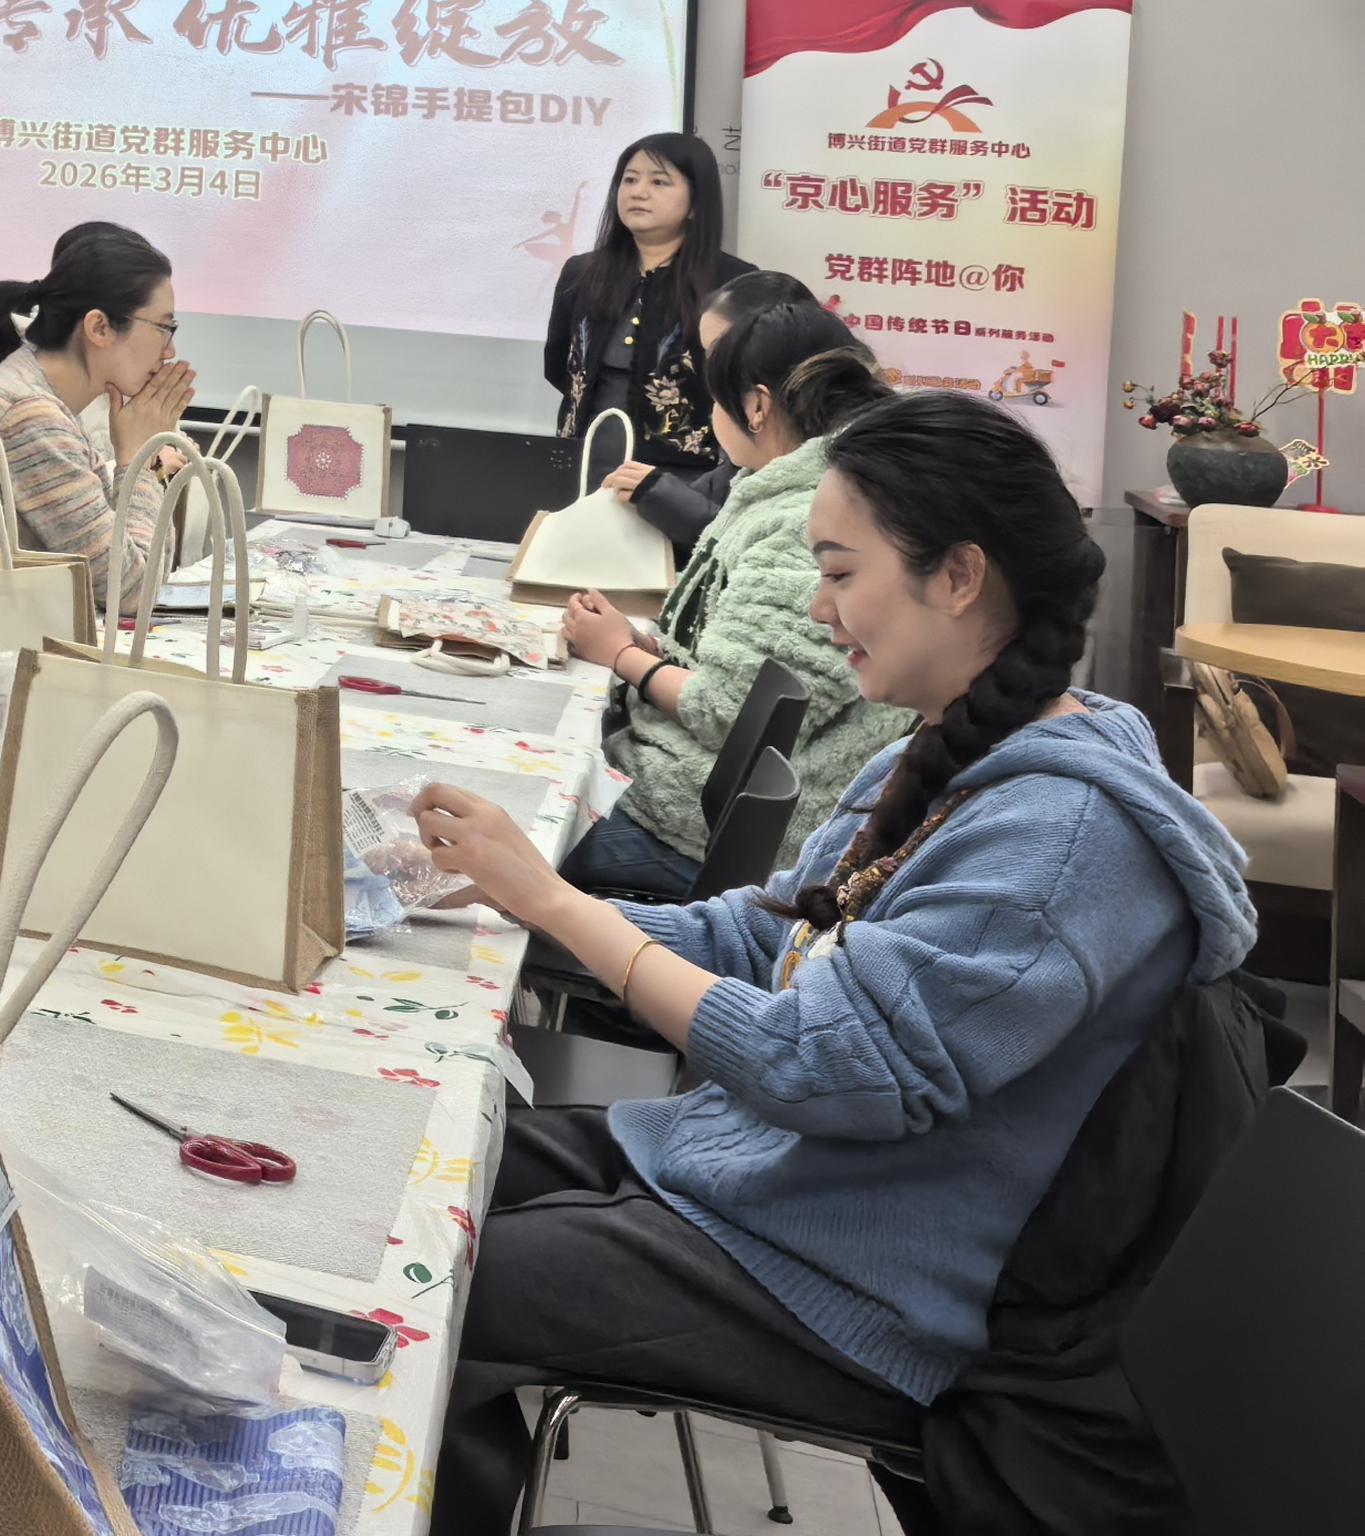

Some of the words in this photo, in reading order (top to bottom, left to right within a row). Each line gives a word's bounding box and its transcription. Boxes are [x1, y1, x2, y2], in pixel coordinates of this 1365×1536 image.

[827, 132, 1031, 159] 博兴街道党群服务中心
[39, 159, 263, 200] 2026年3月4日
[824, 253, 1026, 293] 党群阵地@你
